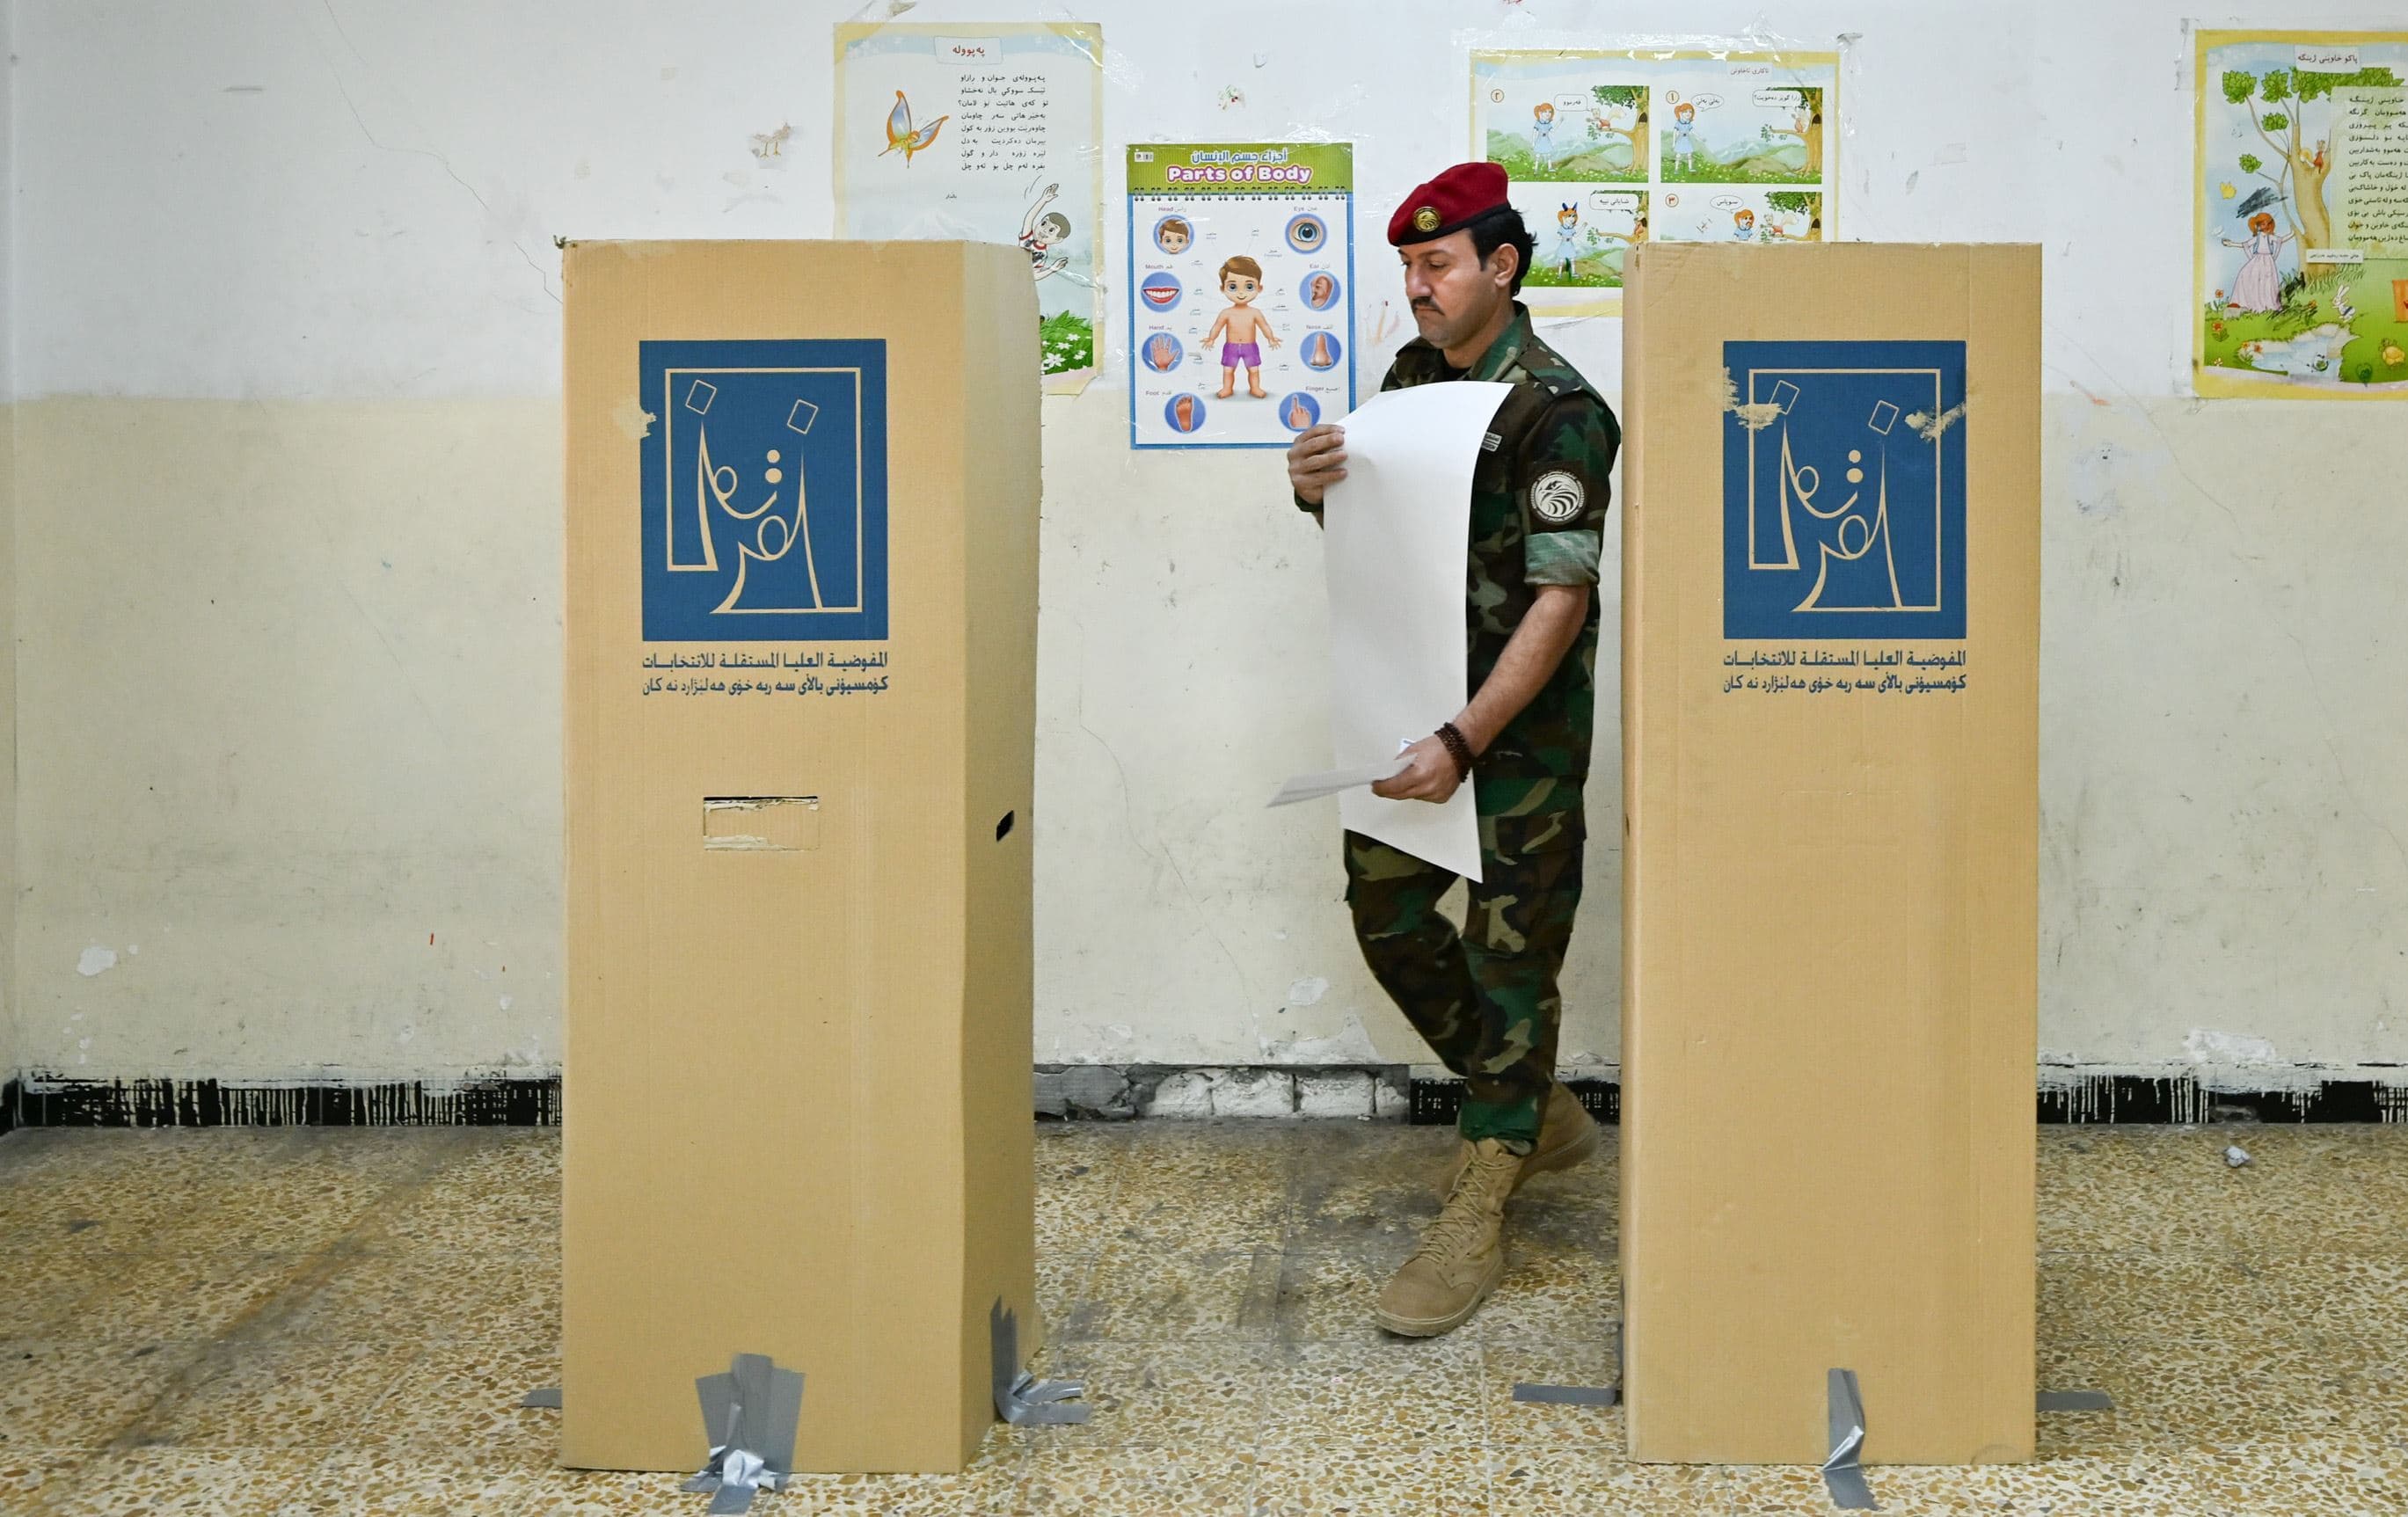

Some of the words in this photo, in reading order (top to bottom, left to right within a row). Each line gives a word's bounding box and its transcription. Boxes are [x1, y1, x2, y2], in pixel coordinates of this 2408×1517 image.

[1167, 165, 1228, 182] Parts
[1230, 164, 1254, 182] of
[1258, 165, 1312, 184] Body
[642, 653, 715, 673] للانتخابات
[719, 652, 779, 668] المستقلة
[784, 652, 823, 672] العليا
[828, 652, 887, 672] المفوضية
[1723, 650, 1796, 670] للانتخابات
[1799, 650, 1859, 667] المستقلة
[1864, 650, 1902, 670] العليا
[1907, 650, 1967, 670] المفوضية
